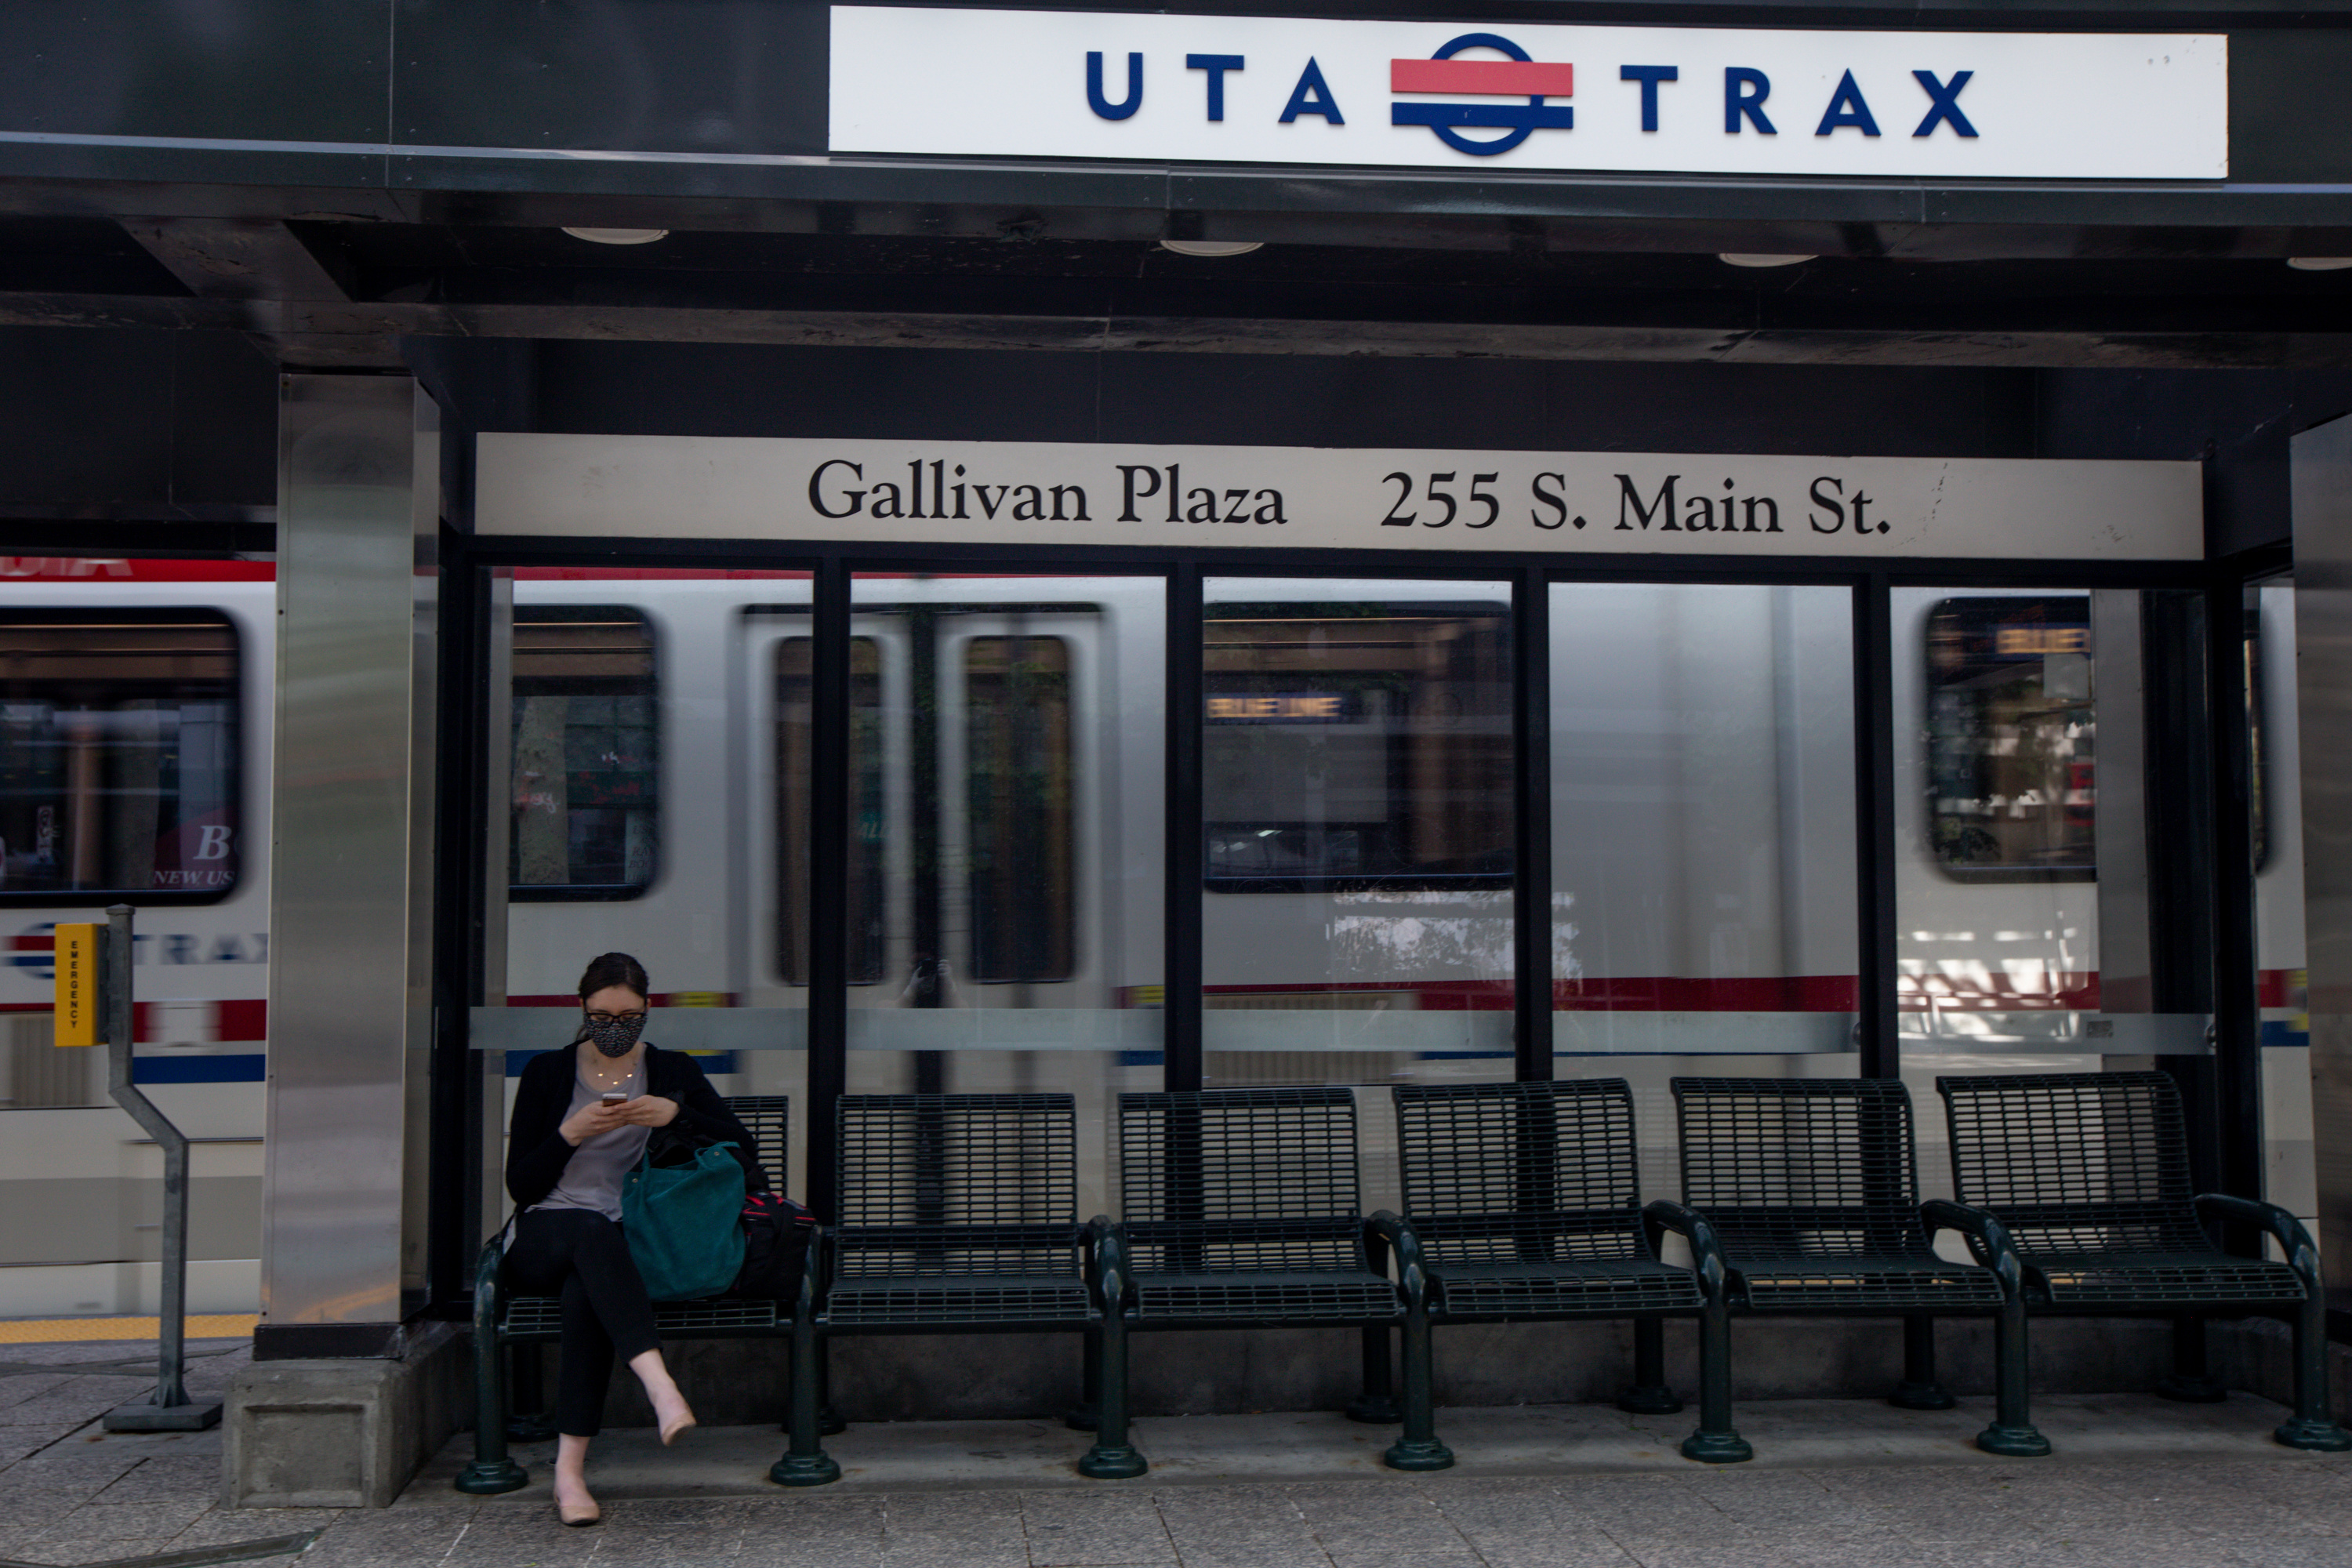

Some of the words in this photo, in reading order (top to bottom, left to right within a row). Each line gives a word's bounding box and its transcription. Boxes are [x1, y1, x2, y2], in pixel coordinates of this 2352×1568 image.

[1086, 51, 1345, 125] UTA
[1620, 65, 1979, 137] TRAX
[808, 459, 1093, 522] Gallivan
[1116, 463, 1288, 524] Plaza
[1381, 470, 1500, 528] 255
[1530, 472, 1587, 530] S.
[1614, 474, 1784, 532] Main
[1809, 476, 1890, 534] St.
[69, 940, 79, 1029] EMERGENCY
